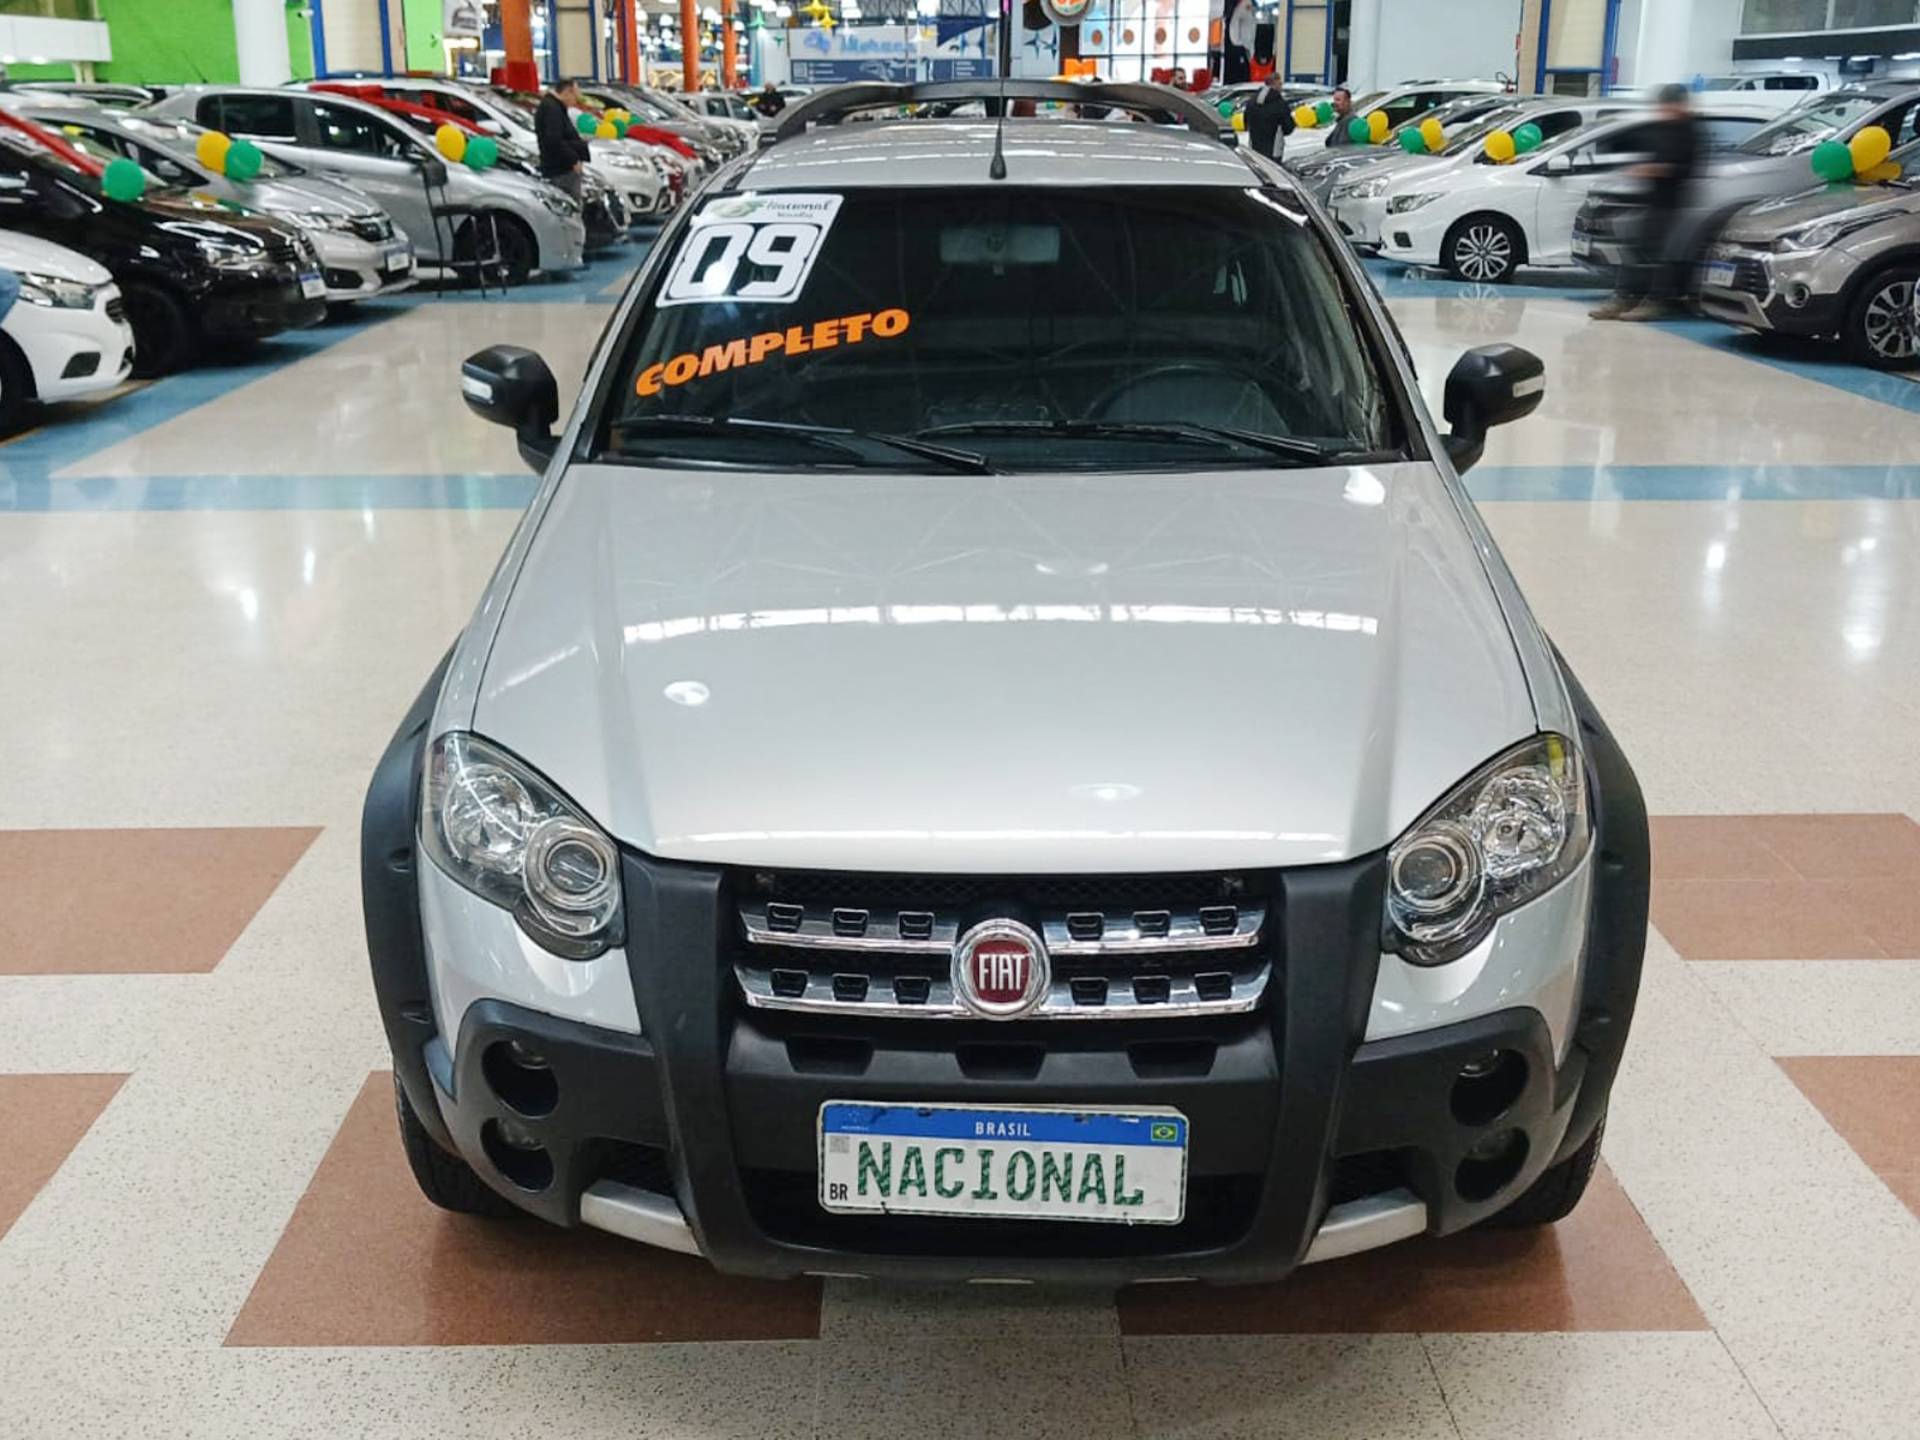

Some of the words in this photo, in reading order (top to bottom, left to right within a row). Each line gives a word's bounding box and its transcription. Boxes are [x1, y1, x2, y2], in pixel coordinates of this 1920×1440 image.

[668, 223, 820, 298] 09
[636, 308, 910, 396] COMPLETO
[979, 953, 1025, 991] FIAT
[975, 1121, 1031, 1137] BRASIL
[829, 1183, 848, 1201] BR
[857, 1141, 1144, 1206] NACIONAL
